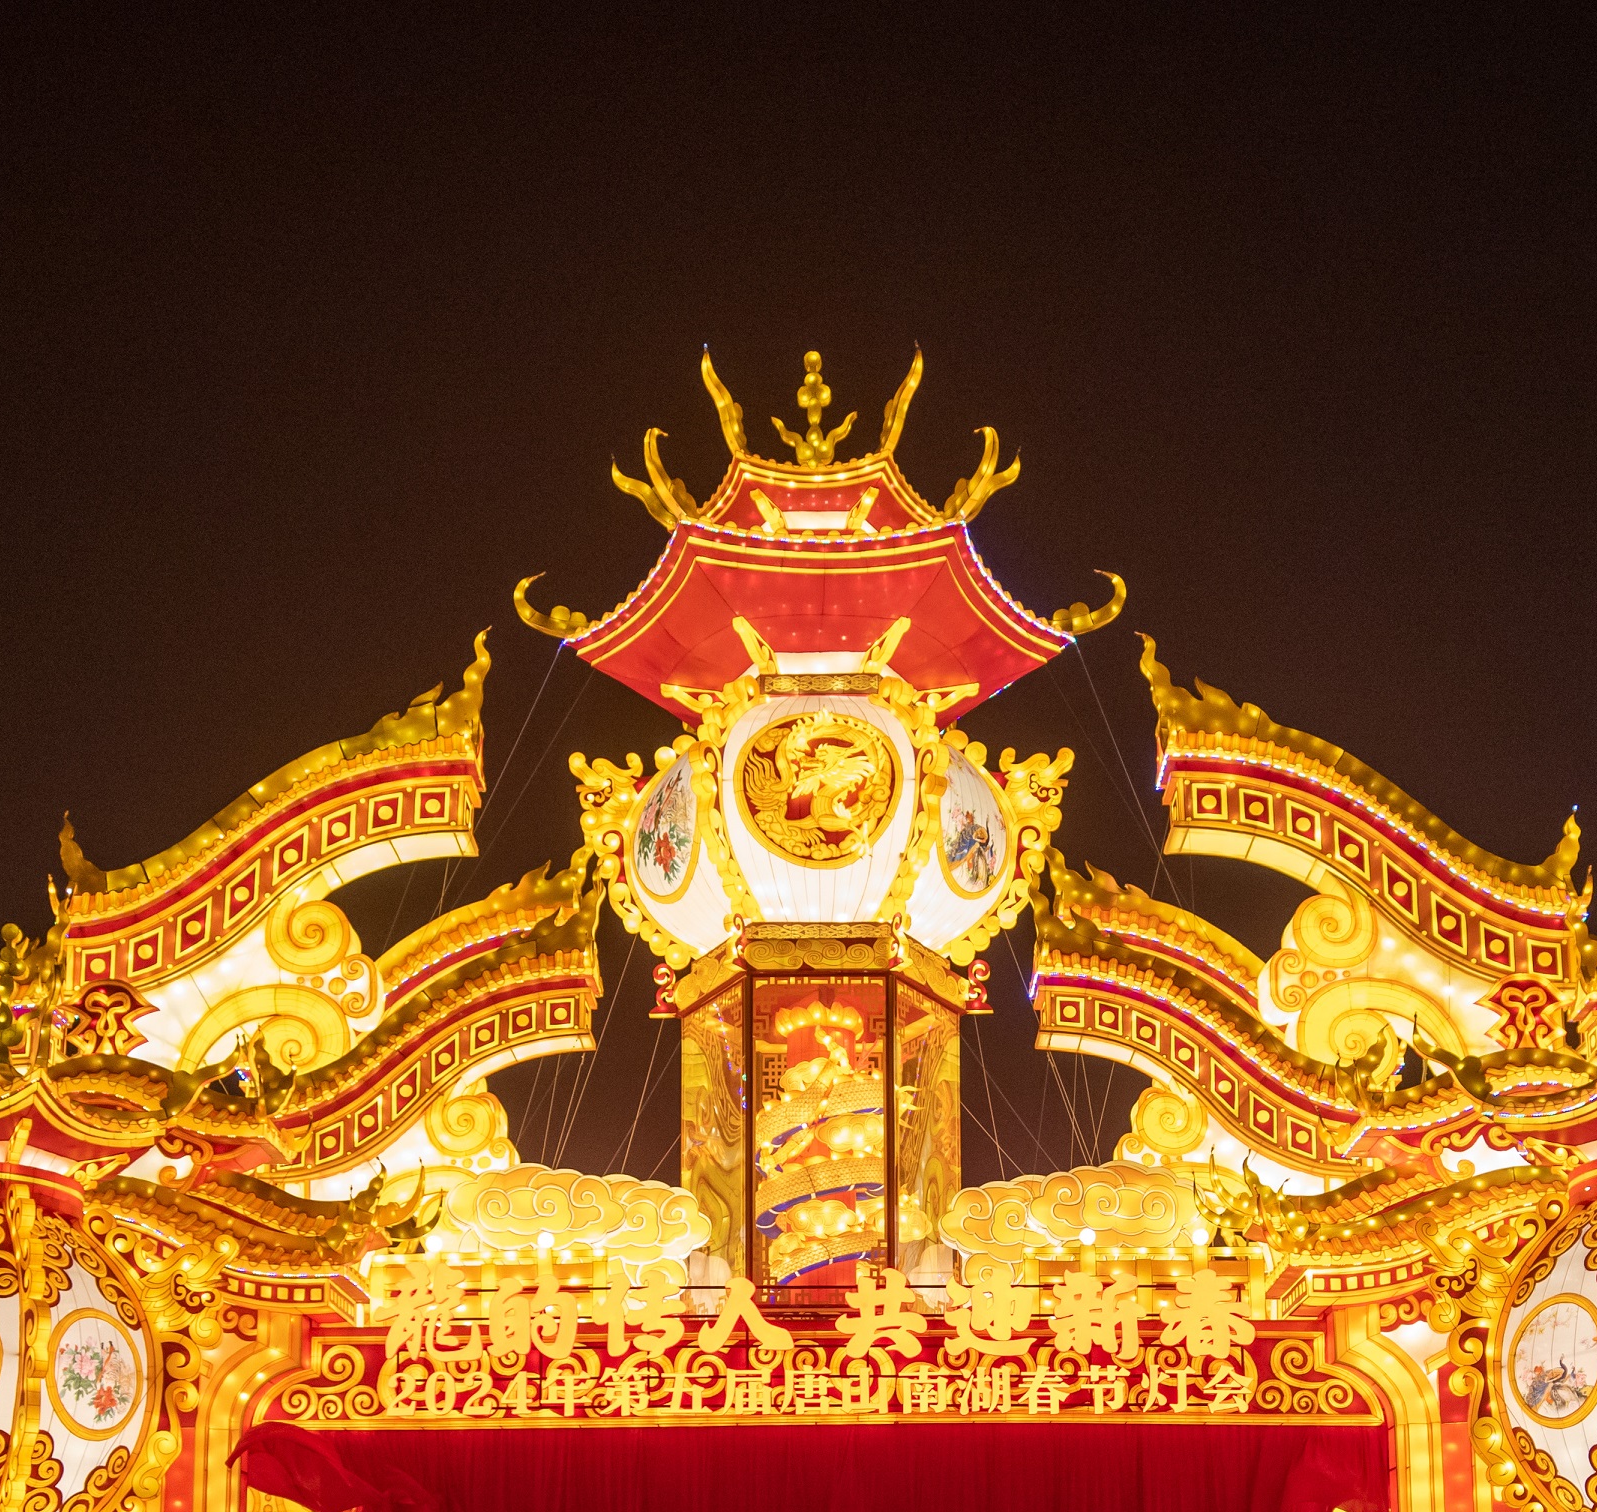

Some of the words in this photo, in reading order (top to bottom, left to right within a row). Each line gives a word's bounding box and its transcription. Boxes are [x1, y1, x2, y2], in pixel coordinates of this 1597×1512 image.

[374, 1262, 795, 1363] 龍的传人
[834, 1267, 1256, 1361] 共迎新春
[385, 1363, 1254, 1418] 2024年第五届唐山南湖春节灯会
